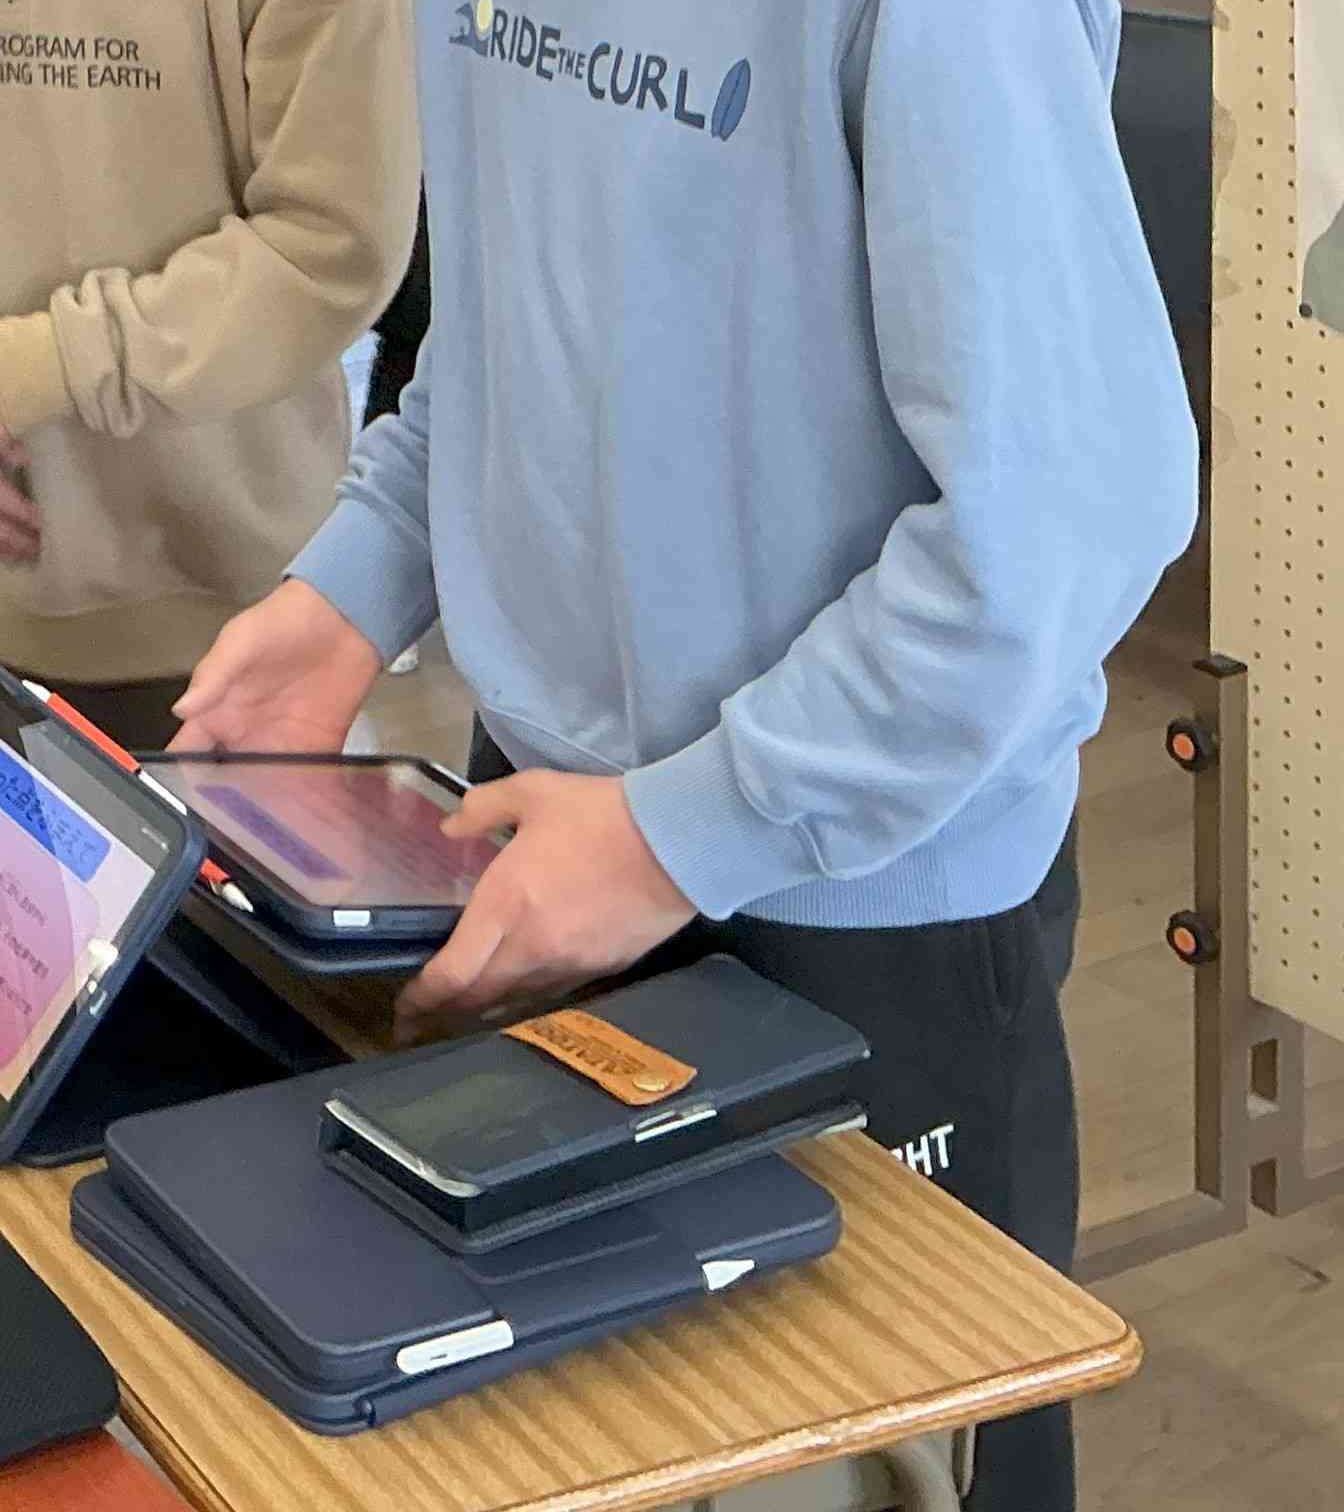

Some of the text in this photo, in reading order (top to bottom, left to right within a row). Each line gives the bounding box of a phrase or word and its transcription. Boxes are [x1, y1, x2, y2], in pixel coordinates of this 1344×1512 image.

[94, 38, 140, 62] FOR
[490, 8, 706, 130] RIDE THE CURL
[39, 63, 79, 89] THE
[87, 64, 161, 91] EARTH
[891, 1122, 954, 1177] HT
